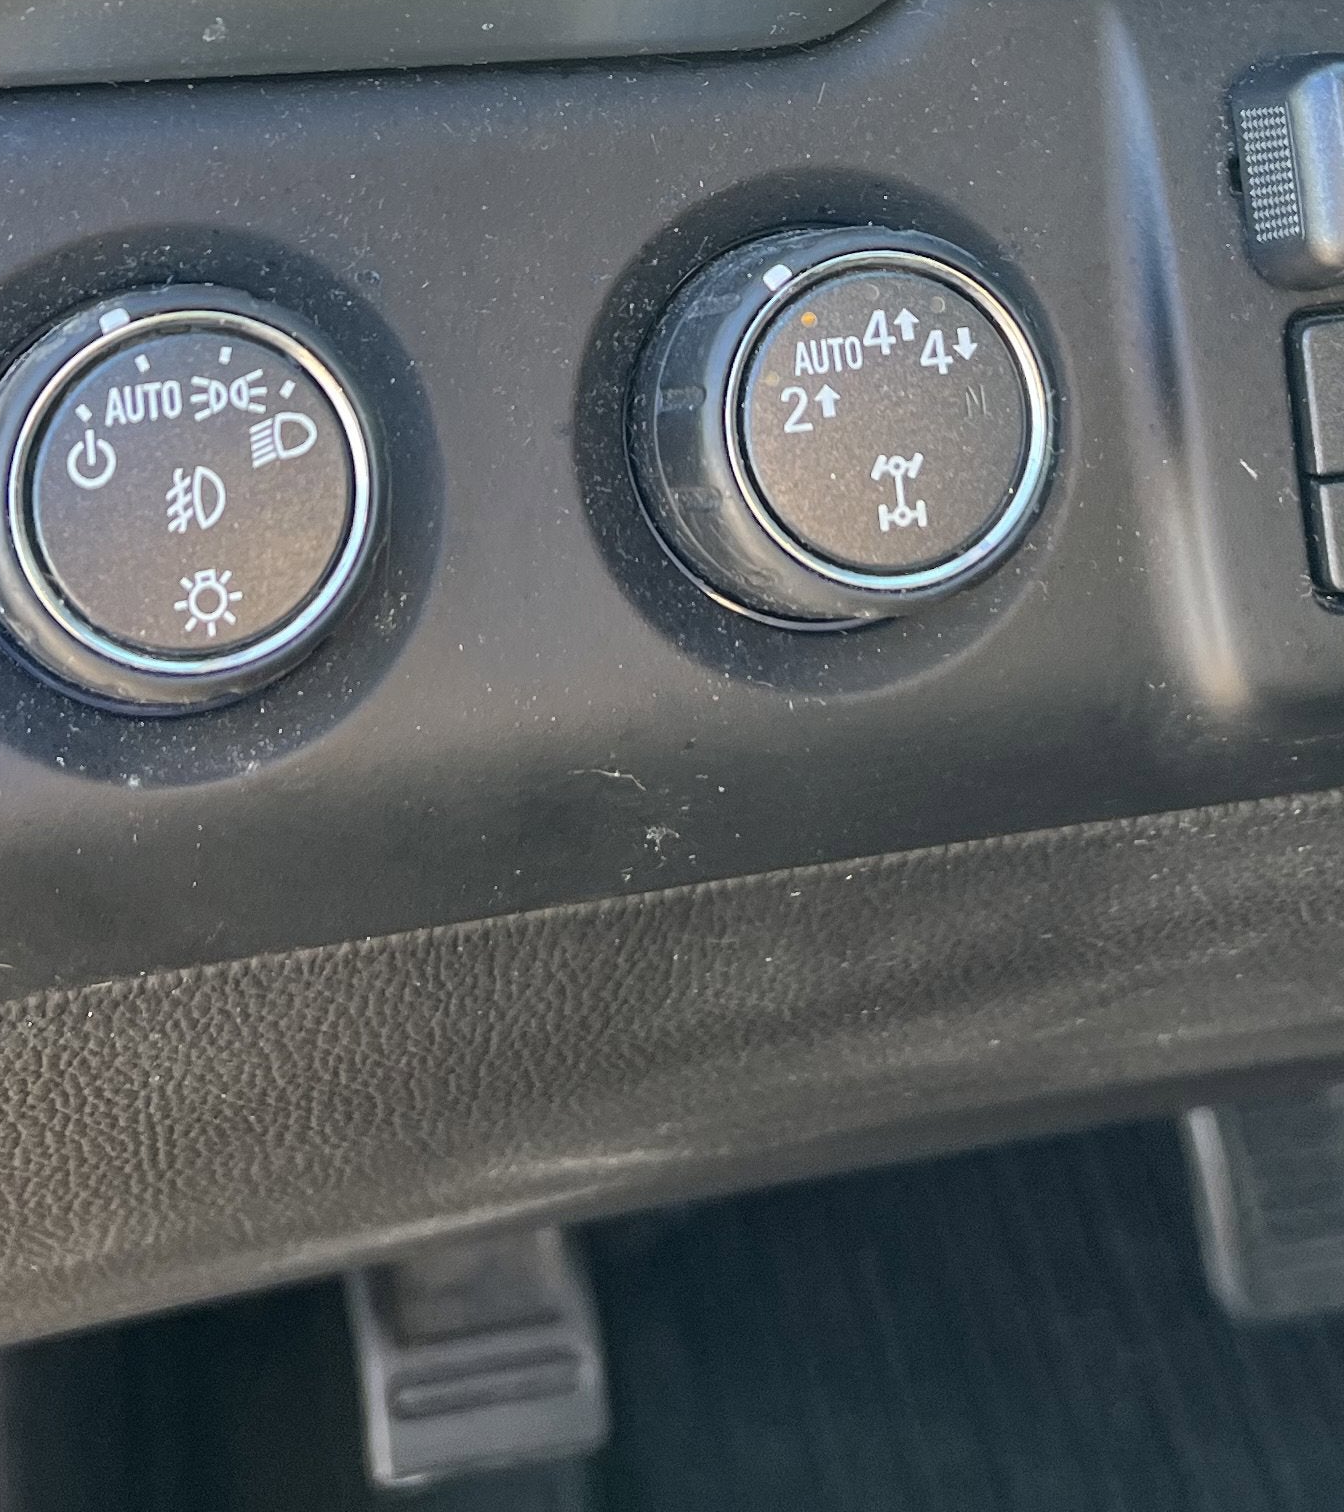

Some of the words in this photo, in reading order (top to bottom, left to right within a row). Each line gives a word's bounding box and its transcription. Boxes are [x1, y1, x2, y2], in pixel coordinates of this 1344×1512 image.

[862, 309, 896, 356] 4
[920, 329, 953, 375] 4
[794, 336, 863, 377] AUTO
[105, 380, 182, 427] AUTO
[780, 386, 814, 434] 2
